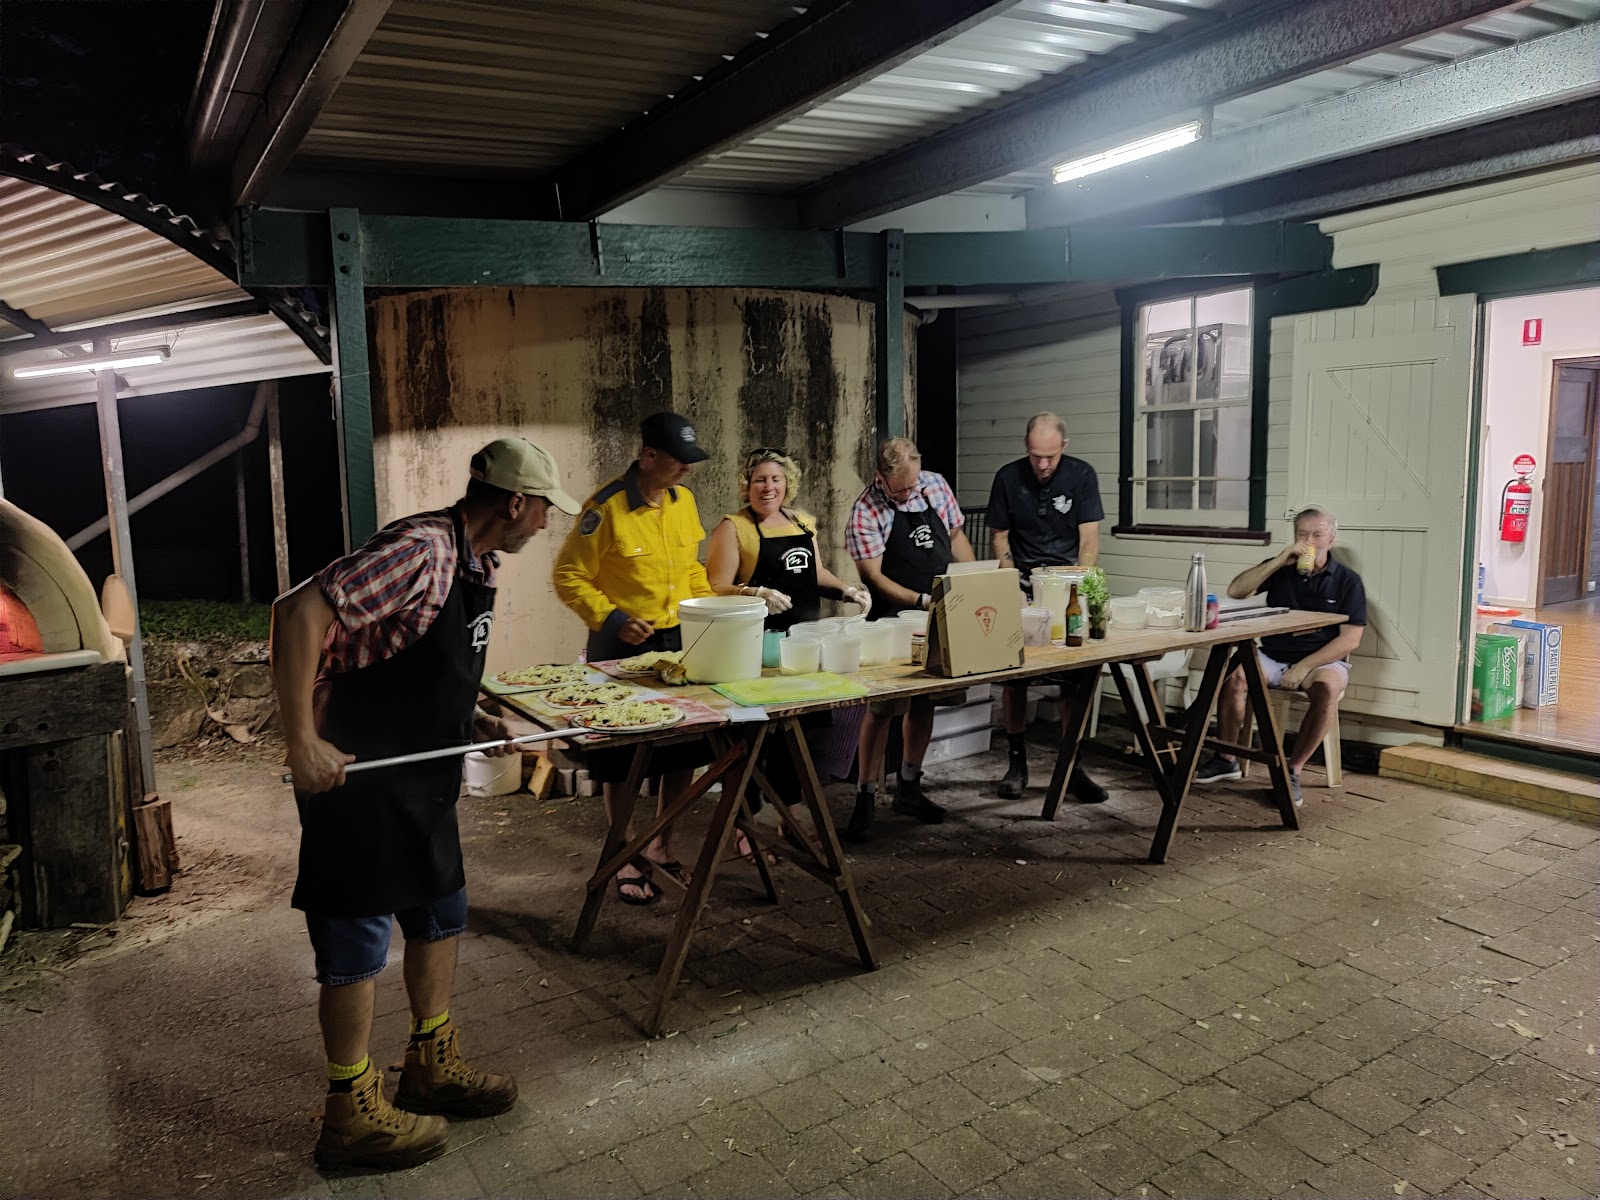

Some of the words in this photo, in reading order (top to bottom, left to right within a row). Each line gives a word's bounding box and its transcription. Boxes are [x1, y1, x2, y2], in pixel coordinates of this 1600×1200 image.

[1503, 646, 1516, 686] Coopers
[1550, 649, 1558, 675] PACIFIC
[1549, 676, 1557, 691] PALE
